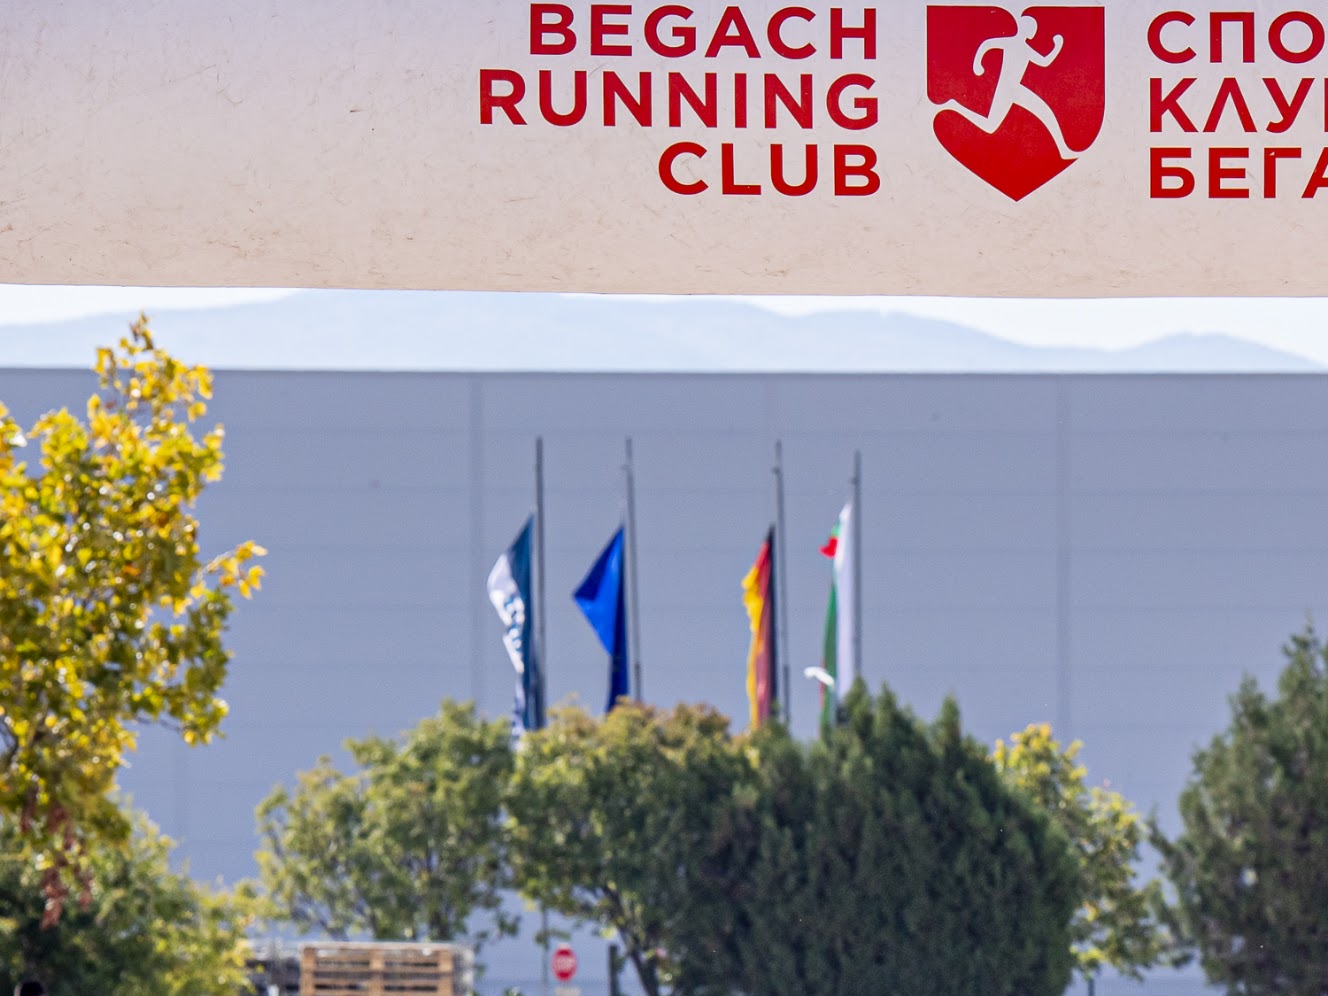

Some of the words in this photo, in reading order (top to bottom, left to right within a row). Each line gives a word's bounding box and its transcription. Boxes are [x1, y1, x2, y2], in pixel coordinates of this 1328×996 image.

[530, 4, 877, 59] BEGACH
[479, 69, 879, 130] RUNNING
[658, 142, 881, 196] CLUB
